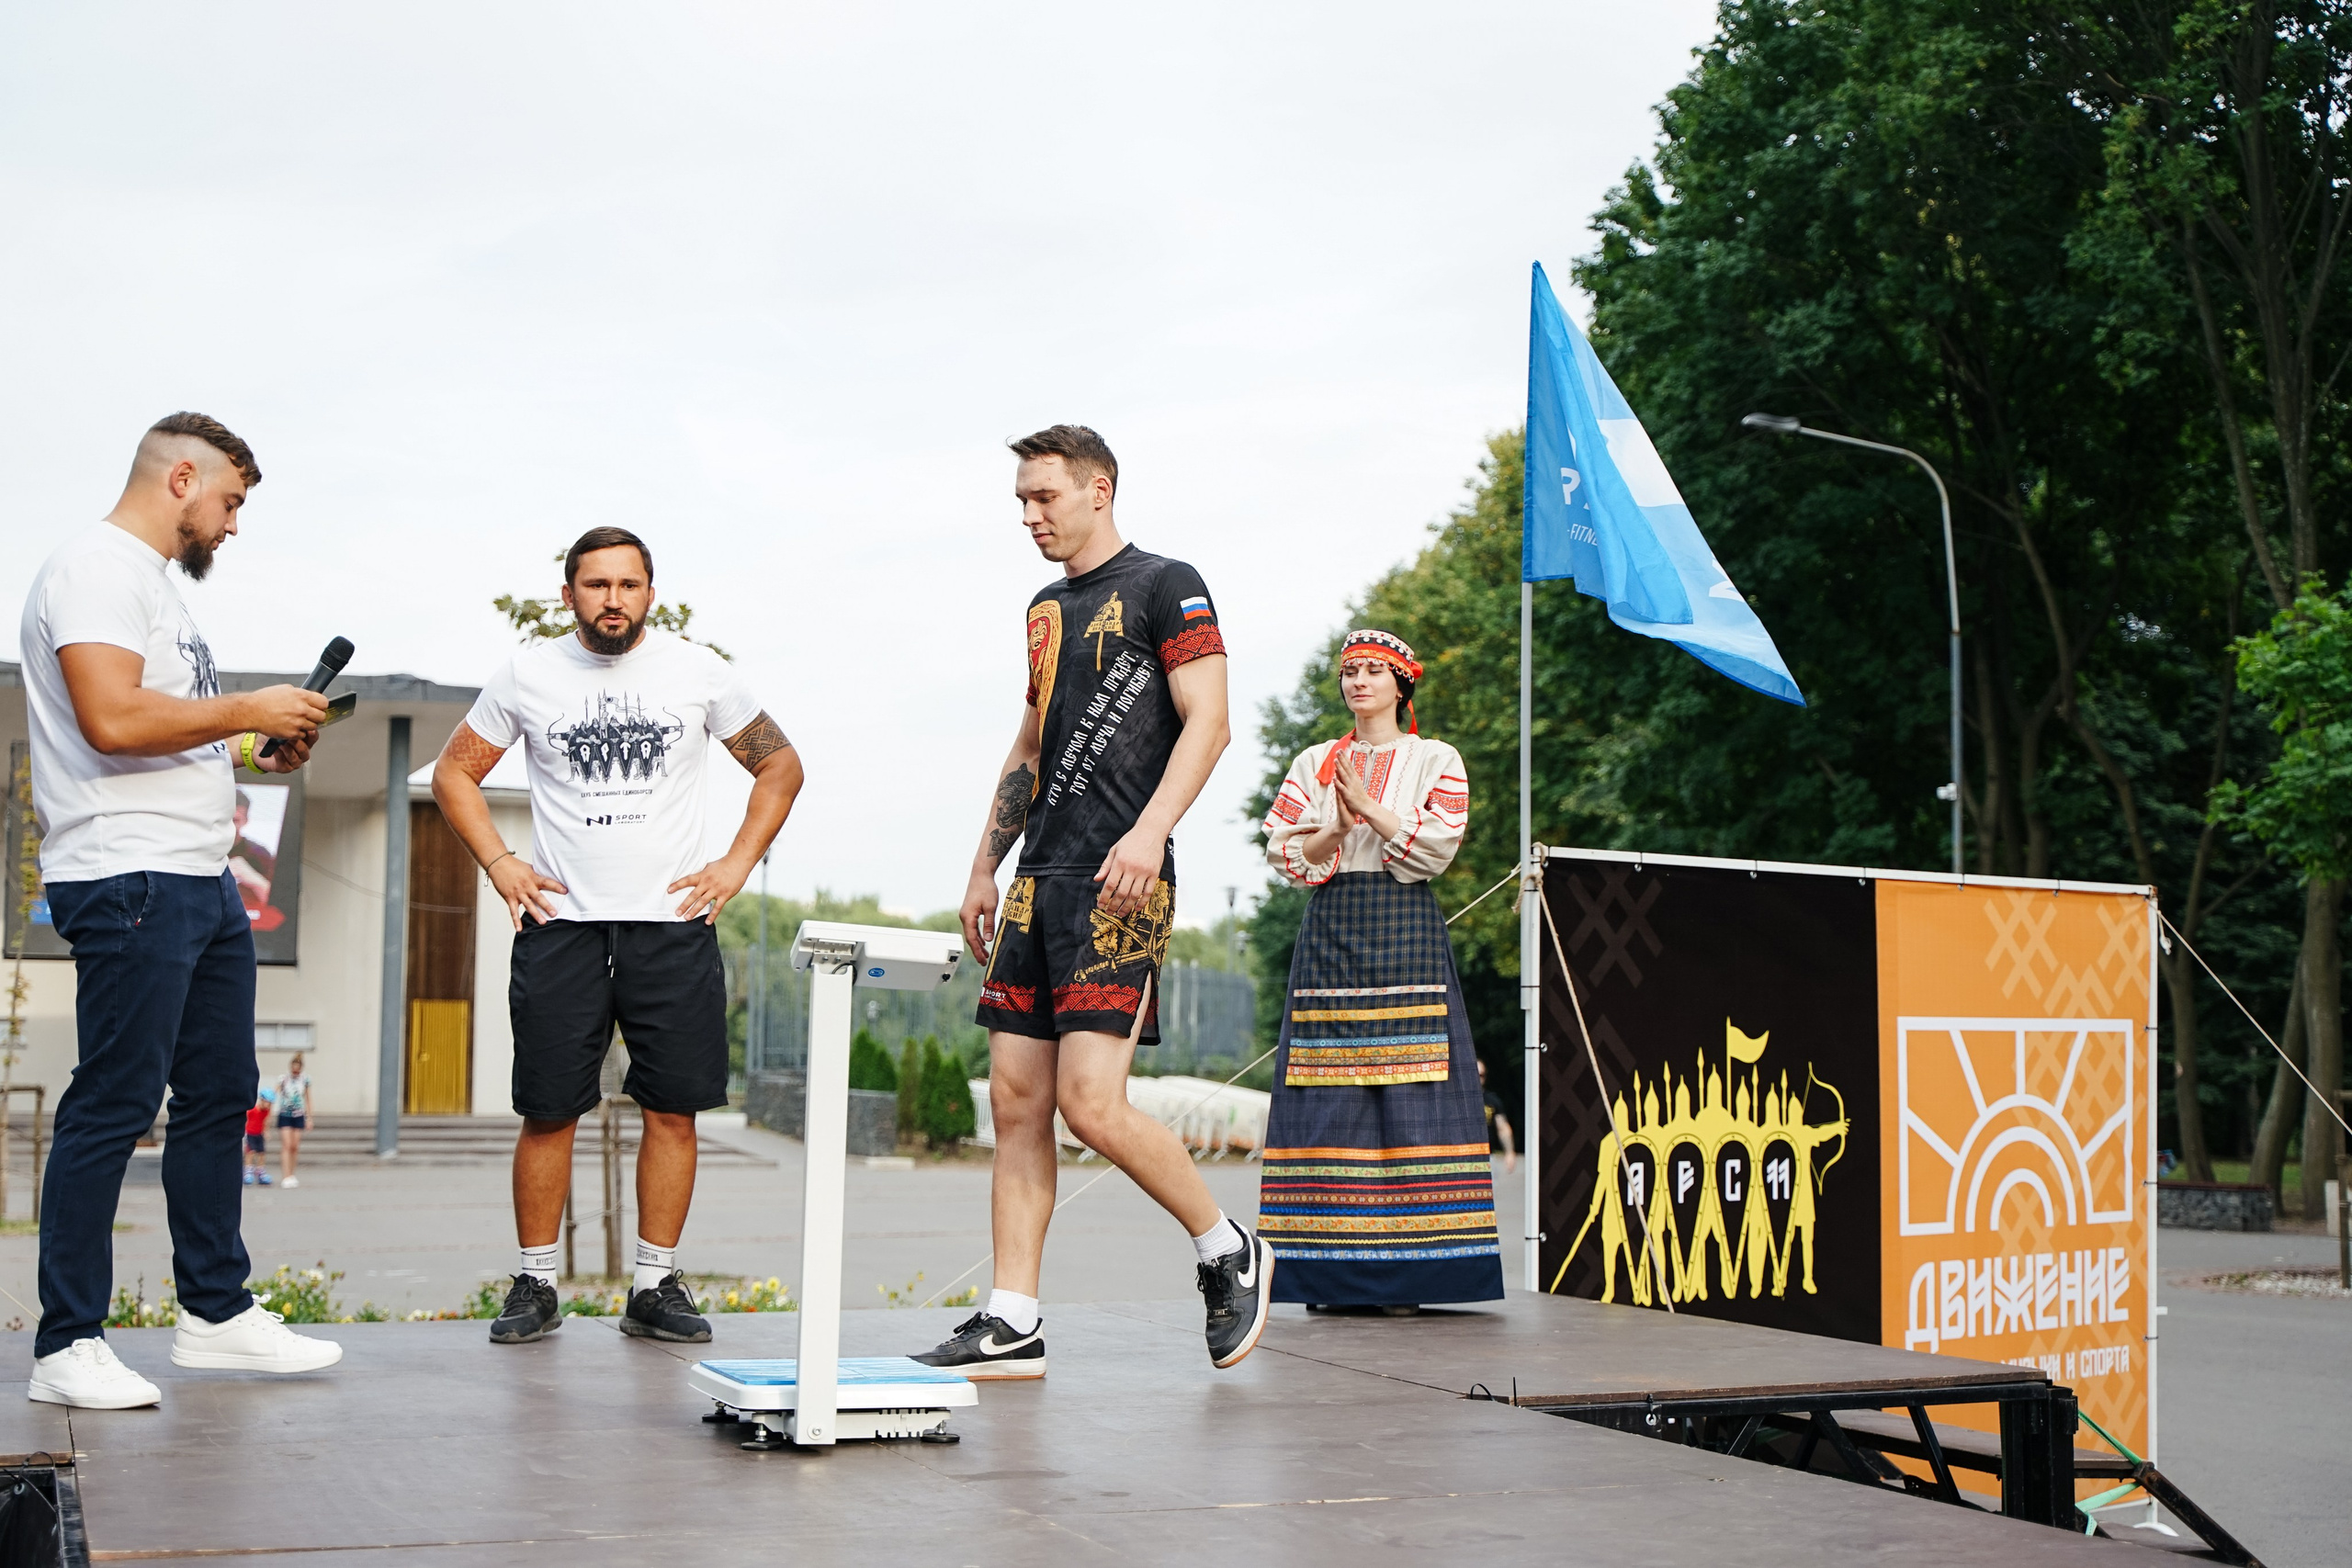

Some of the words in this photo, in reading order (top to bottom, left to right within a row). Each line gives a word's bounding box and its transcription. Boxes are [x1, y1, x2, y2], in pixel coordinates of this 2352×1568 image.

[1114, 660, 1155, 713] ПОГИБНЕТ
[1086, 692, 1112, 718] НАМ
[1080, 717, 1095, 730] К
[1107, 711, 1124, 725] И
[1060, 730, 1089, 772] МЕЧОМ
[1090, 724, 1117, 756] МЕЧА
[1081, 754, 1096, 773] ОТ
[1056, 771, 1068, 783] С
[1069, 772, 1090, 796] ТОТ
[1046, 782, 1062, 807] КТО
[1905, 1247, 2131, 1355] ДВИЖЕНИЕ
[2065, 1351, 2075, 1380] И
[2080, 1344, 2131, 1379] СПОРТА
